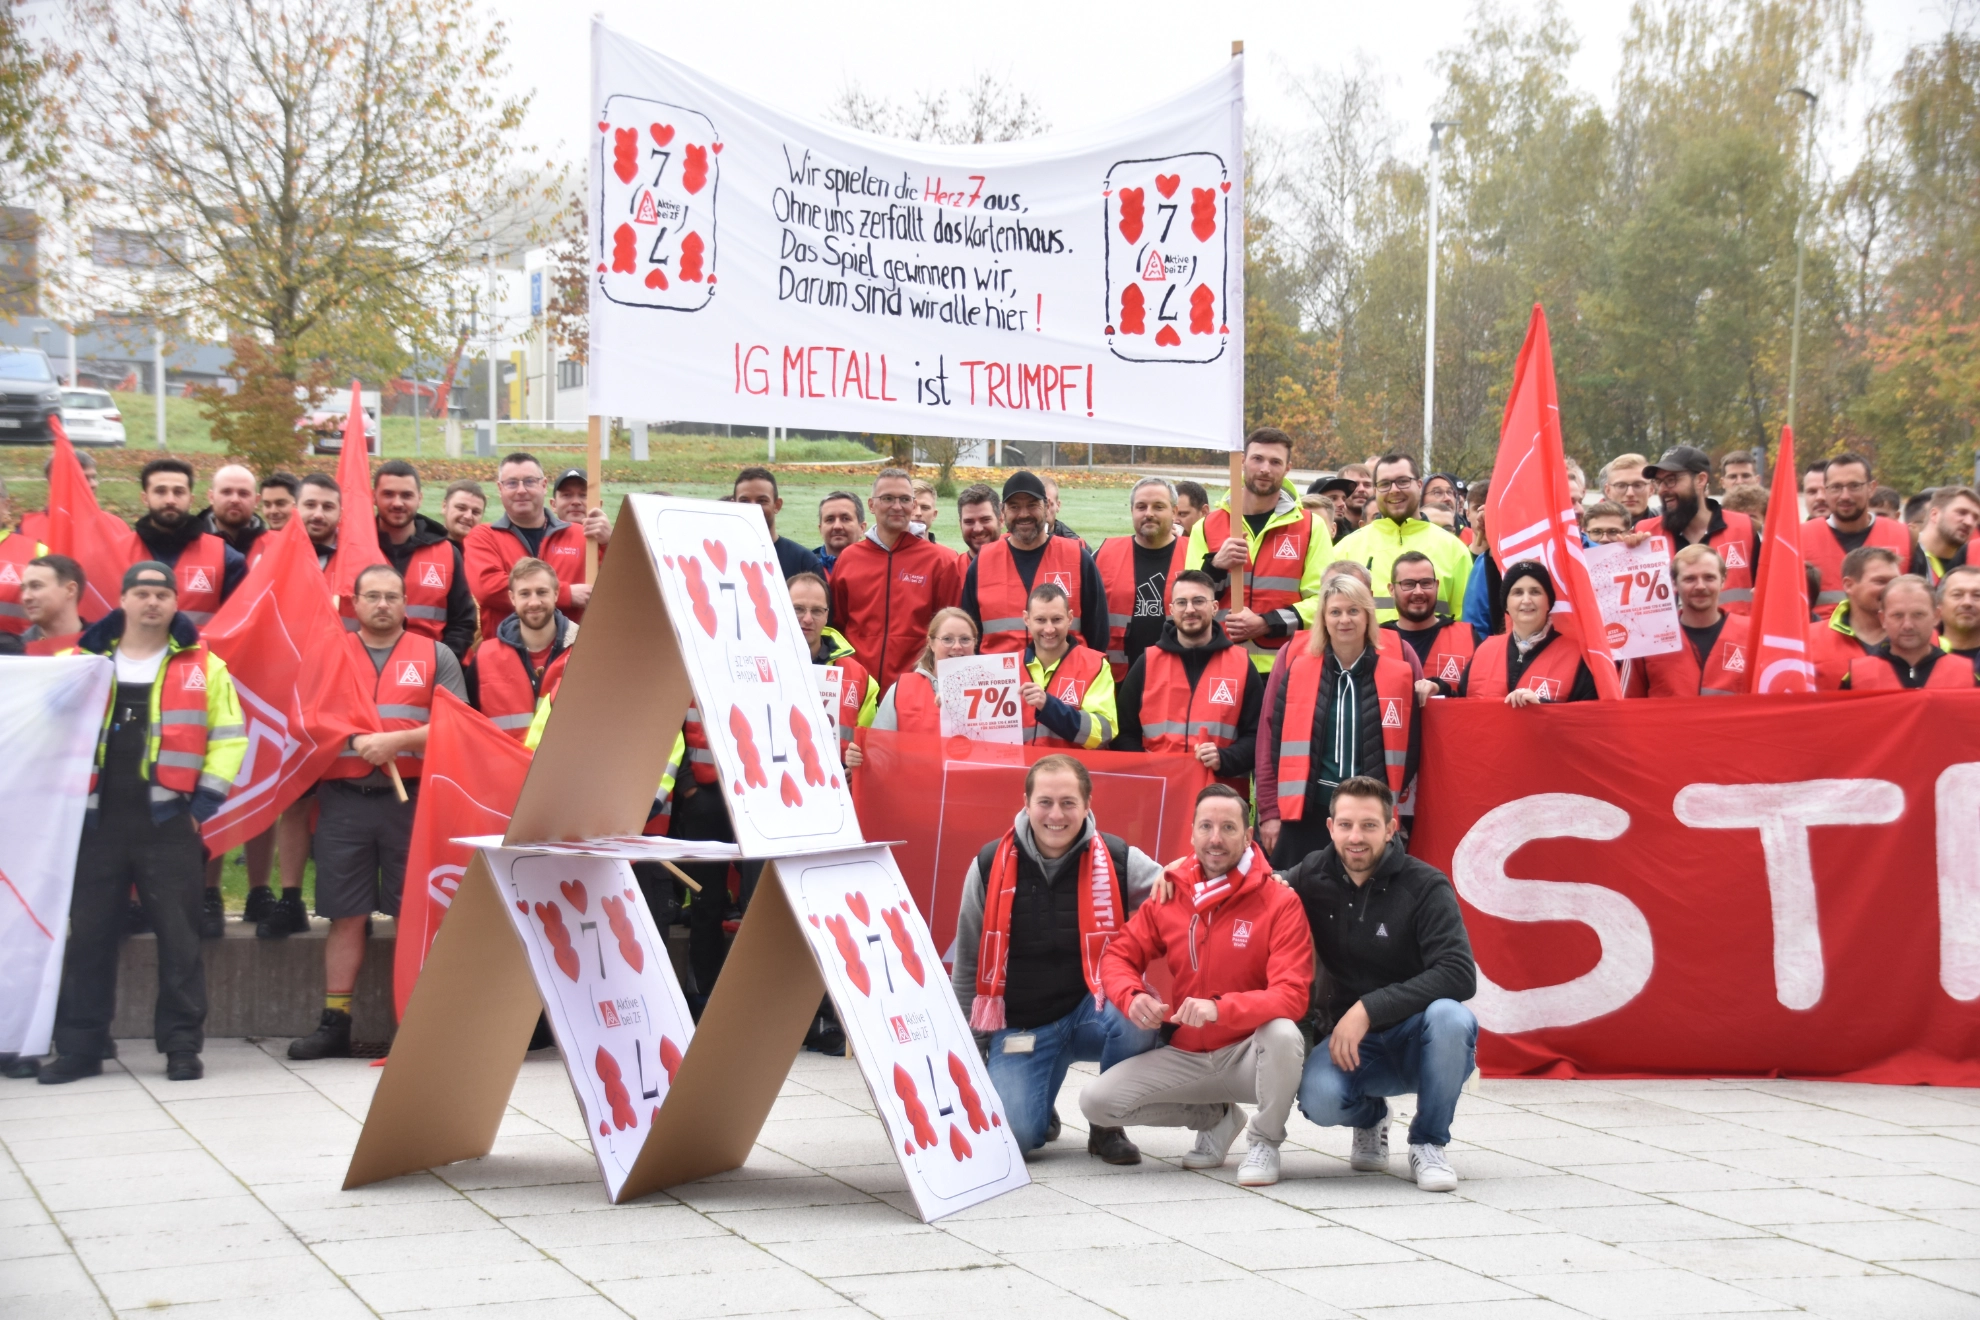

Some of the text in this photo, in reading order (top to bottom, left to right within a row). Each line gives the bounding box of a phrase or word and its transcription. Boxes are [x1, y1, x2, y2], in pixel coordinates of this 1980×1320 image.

[651, 148, 671, 187] 7
[783, 143, 1029, 214] Wir spielen die Herz 7 aus,
[657, 199, 681, 213] Aktive
[657, 209, 680, 221] bei ZF
[772, 187, 822, 230] Ohne
[825, 207, 855, 236] uns
[934, 207, 962, 244] das
[1157, 203, 1178, 243] 7
[781, 228, 1017, 298] Das Spiel gewinnen wir,
[1164, 254, 1189, 265] Aktive
[1164, 265, 1188, 274] bei ZF
[779, 265, 848, 308] Darum
[852, 278, 902, 316] sind
[909, 291, 939, 319] wir
[939, 293, 981, 326] alle
[735, 342, 1094, 417] IG METALL ist TRUMPF!
[1613, 569, 1669, 606] 7%
[718, 581, 742, 641] 7
[963, 687, 1017, 720] 7%
[1452, 762, 1980, 1033] ST
[580, 921, 606, 980] 7
[866, 933, 894, 993] 7
[616, 997, 639, 1010] Aktive
[620, 1011, 642, 1026] bei ZF
[905, 1012, 925, 1025] Aktive
[910, 1026, 929, 1041] bei ZF
